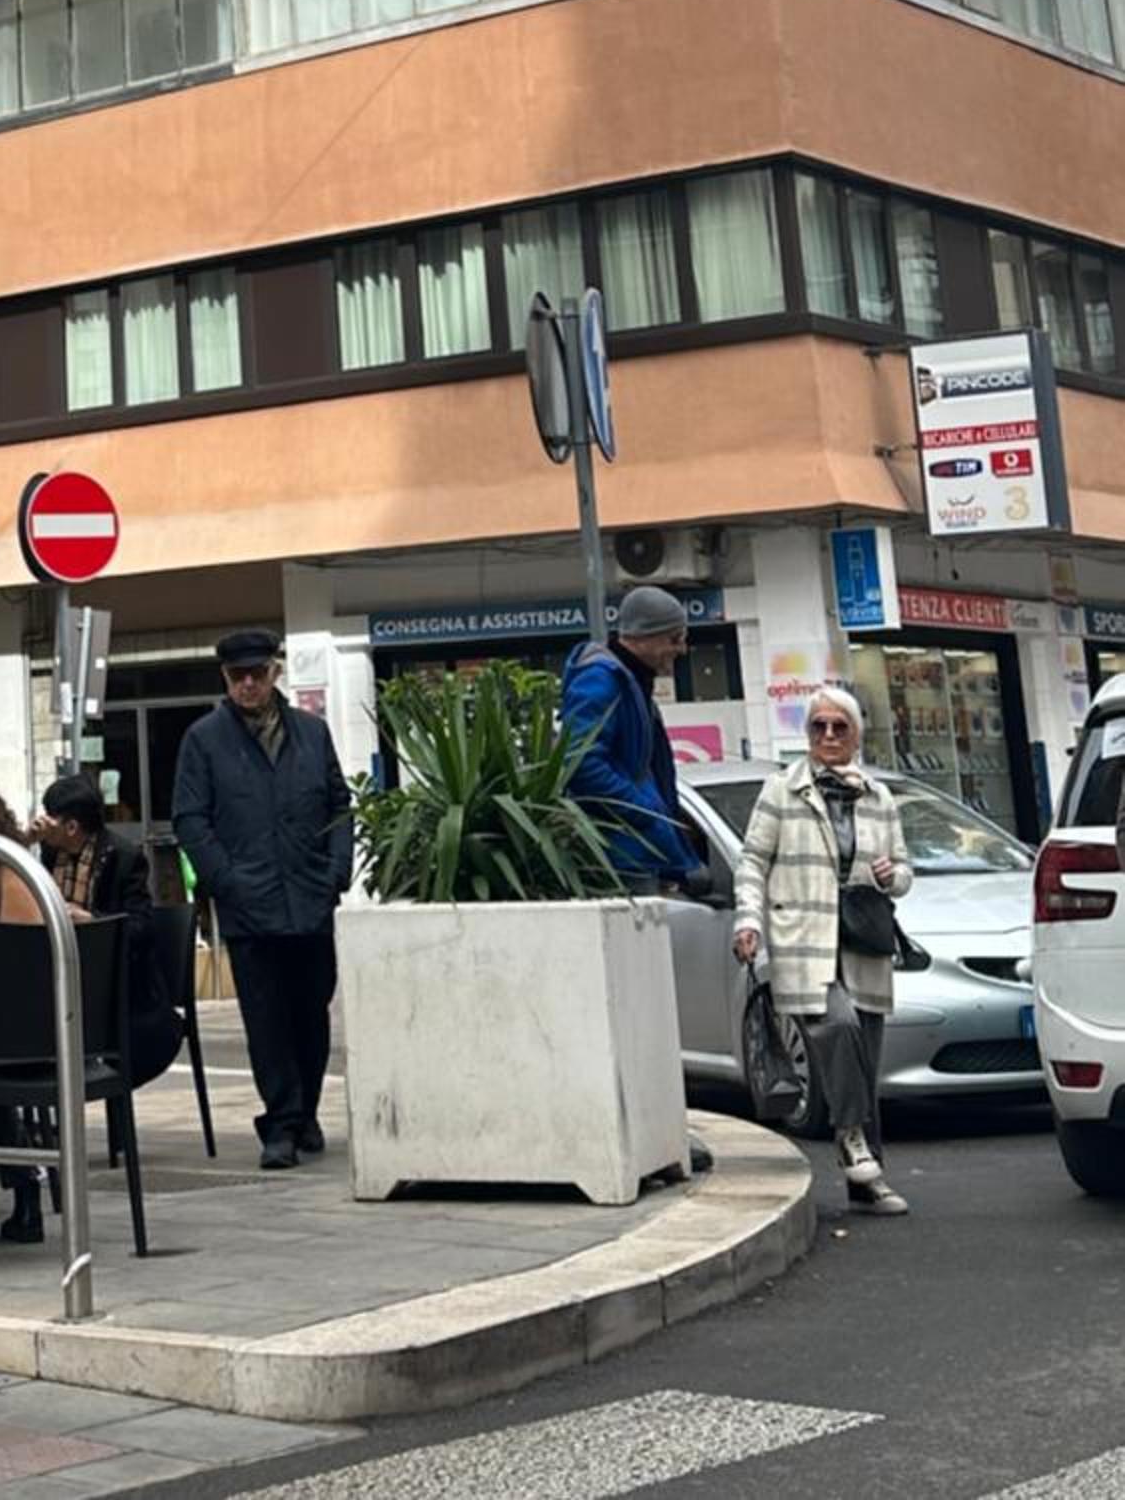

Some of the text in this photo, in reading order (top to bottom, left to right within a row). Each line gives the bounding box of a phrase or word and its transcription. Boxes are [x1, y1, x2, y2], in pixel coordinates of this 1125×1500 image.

[947, 369, 1027, 392] PINCODE
[956, 461, 977, 474] TIM
[937, 506, 986, 520] WIND
[374, 611, 465, 636] CONSEGNA
[469, 611, 478, 631] E
[482, 607, 586, 629] ASSISTENZA
